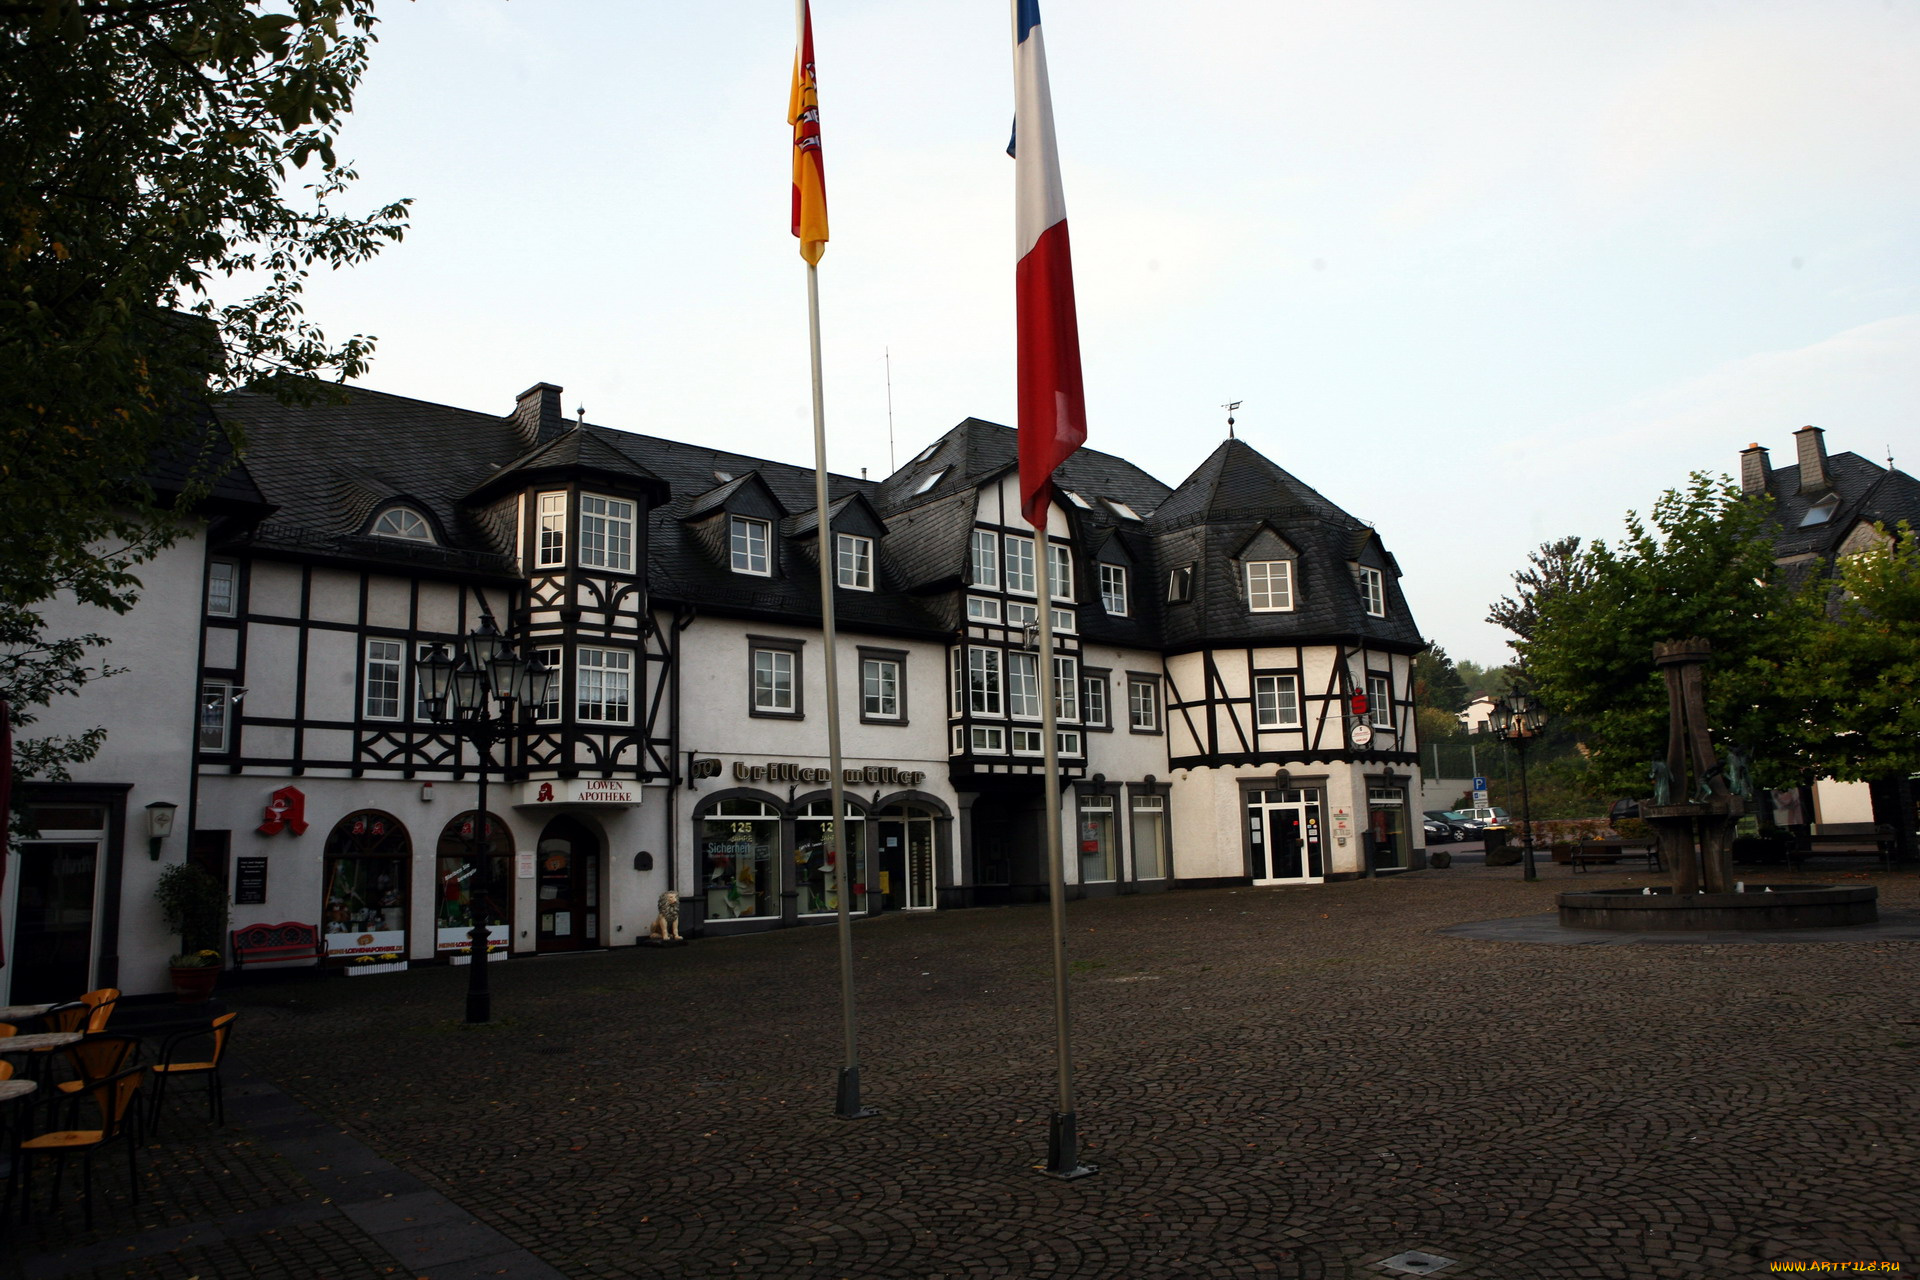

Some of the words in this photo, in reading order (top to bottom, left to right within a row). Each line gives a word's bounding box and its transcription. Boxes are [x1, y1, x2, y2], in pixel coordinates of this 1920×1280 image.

[733, 761, 831, 783] brillen
[843, 765, 926, 785] müller
[578, 791, 632, 801] APOTHEKE
[730, 822, 753, 833] 125
[820, 822, 834, 833] 12
[708, 842, 751, 855] Sicherheit
